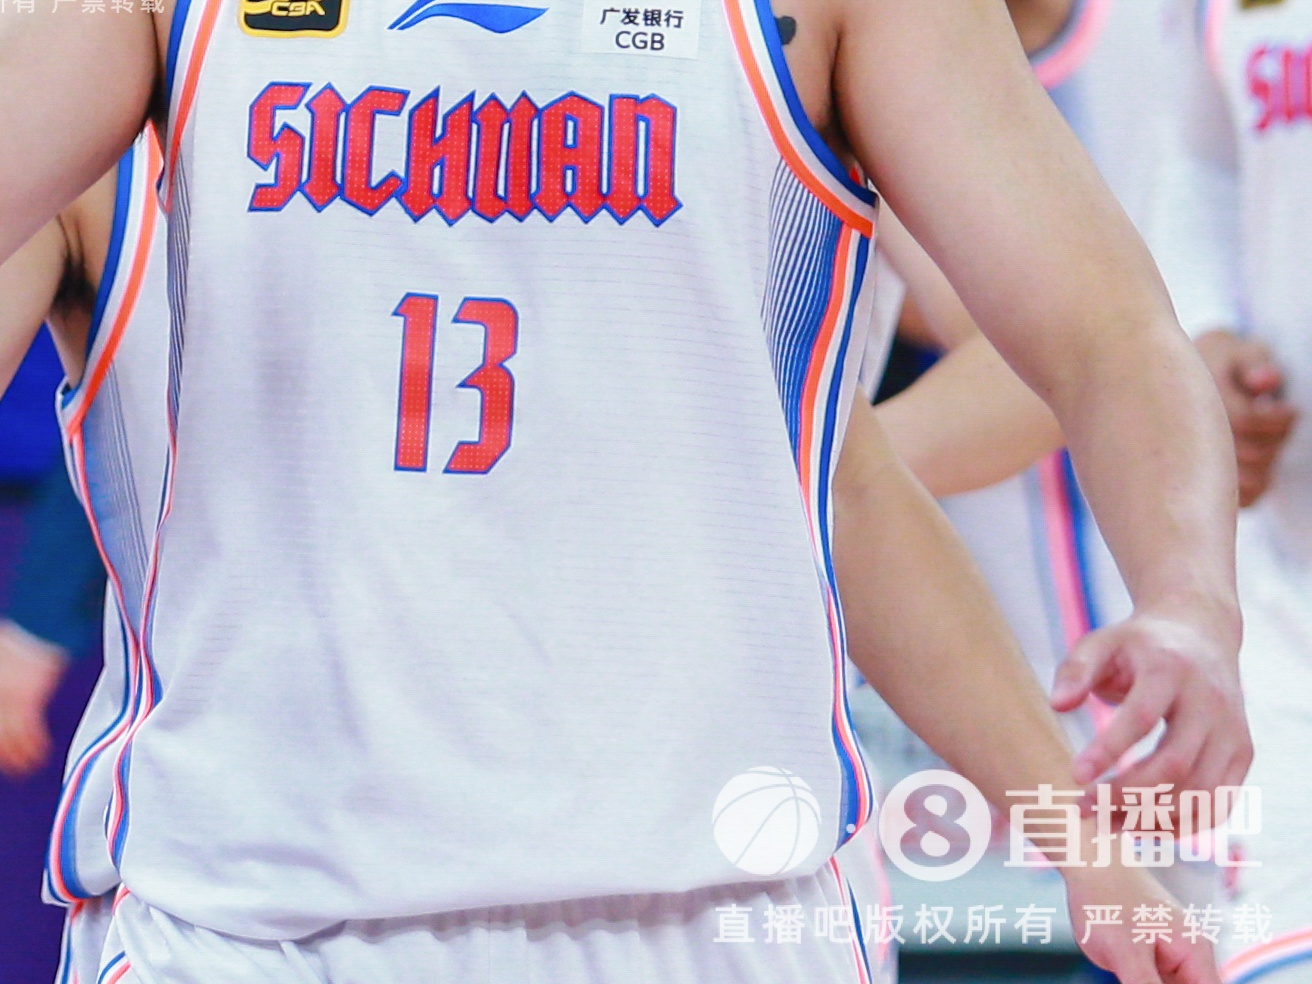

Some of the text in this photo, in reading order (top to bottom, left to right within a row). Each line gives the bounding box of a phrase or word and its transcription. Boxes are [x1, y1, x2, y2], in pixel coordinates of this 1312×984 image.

[271, 0, 326, 17] CBA
[599, 6, 684, 29] 广发银行
[614, 30, 666, 51] CGB
[246, 80, 684, 228] SICHUAN
[390, 292, 519, 475] 13
